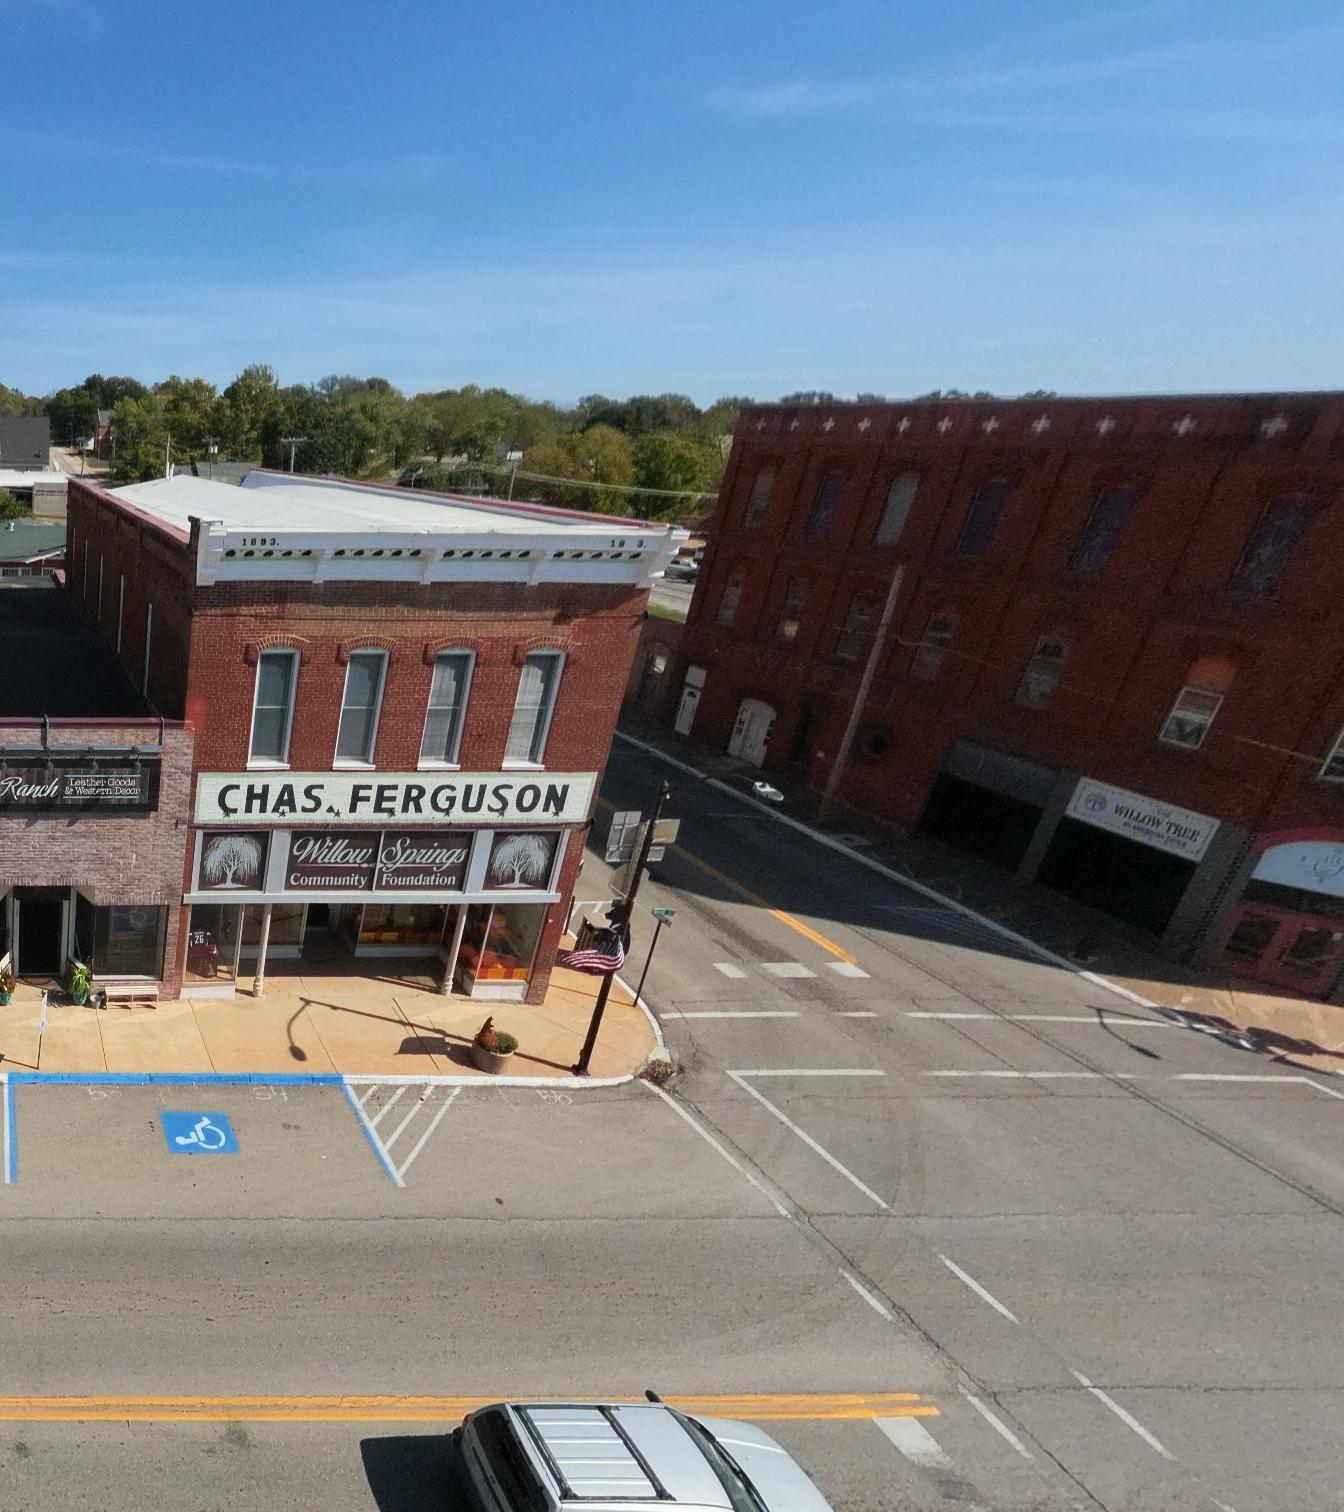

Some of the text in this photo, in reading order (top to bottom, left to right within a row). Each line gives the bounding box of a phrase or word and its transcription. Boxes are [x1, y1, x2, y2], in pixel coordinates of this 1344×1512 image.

[64, 786, 141, 795] & Western Decor
[70, 778, 136, 787] Leather Goods
[349, 783, 570, 815] FERGUSON
[1114, 803, 1163, 831] WILLOW
[1165, 819, 1202, 842] TREE
[292, 836, 469, 873] Willow Springs
[289, 872, 457, 888] Community Foundation
